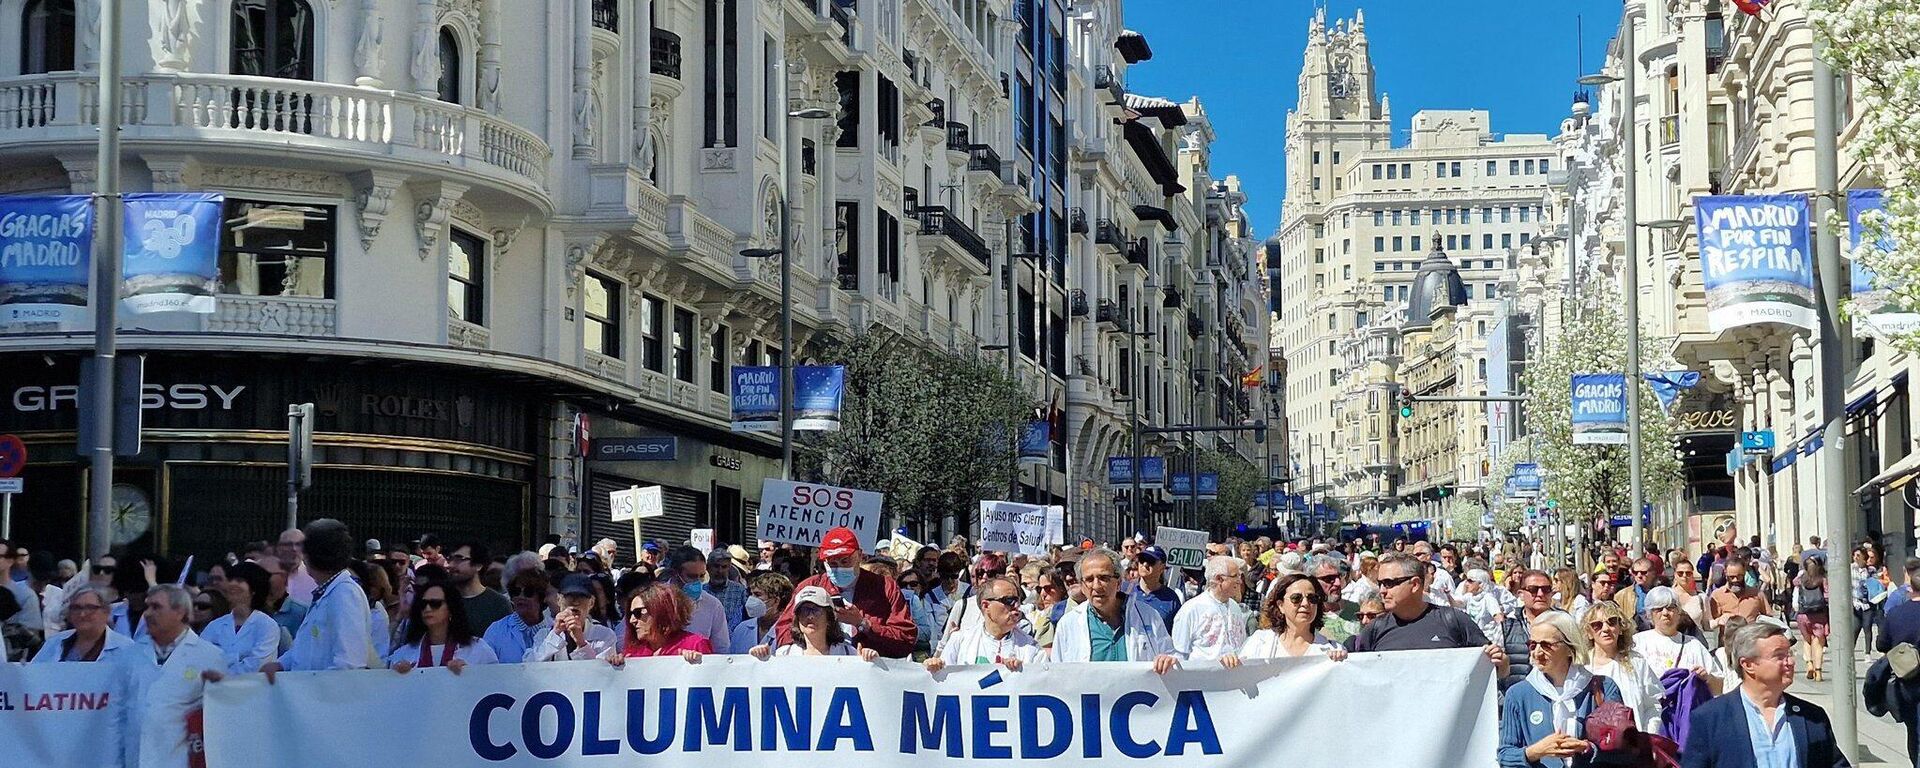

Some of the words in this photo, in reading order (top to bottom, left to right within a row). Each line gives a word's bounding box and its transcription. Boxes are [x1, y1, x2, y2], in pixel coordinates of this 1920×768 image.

[0, 211, 86, 238] GRACIAS
[145, 210, 177, 219] MADRID
[1710, 204, 1799, 230] MADRID
[1720, 229, 1757, 248] POR
[1760, 228, 1791, 246] FIN
[1, 241, 80, 268] MADRID
[1704, 246, 1805, 278] RESPIRA
[23, 309, 60, 318] MADRID
[1750, 307, 1793, 318] MADRID
[737, 371, 775, 385] MADRID
[13, 383, 246, 411] GRSSY
[740, 385, 755, 395] POR
[756, 384, 770, 394] FIN
[1575, 383, 1623, 399] GRACIAS
[361, 393, 449, 420] ROLEX
[735, 394, 776, 407] RESPIRA
[1578, 399, 1621, 414] MADRID
[602, 444, 670, 454] GRASSY
[611, 495, 634, 515] MAS
[793, 486, 854, 510] SOS
[768, 505, 865, 531] ATENCIÓN
[1008, 512, 1022, 524] nos
[1023, 512, 1045, 527] cierra
[765, 523, 828, 543] PRIMA
[982, 527, 1007, 543] Centros
[1008, 530, 1018, 543] de
[1168, 548, 1203, 567] SALUD
[24, 691, 110, 711] LATINA
[469, 686, 875, 761] COLUMNA
[899, 669, 1223, 759] MÉDICA
